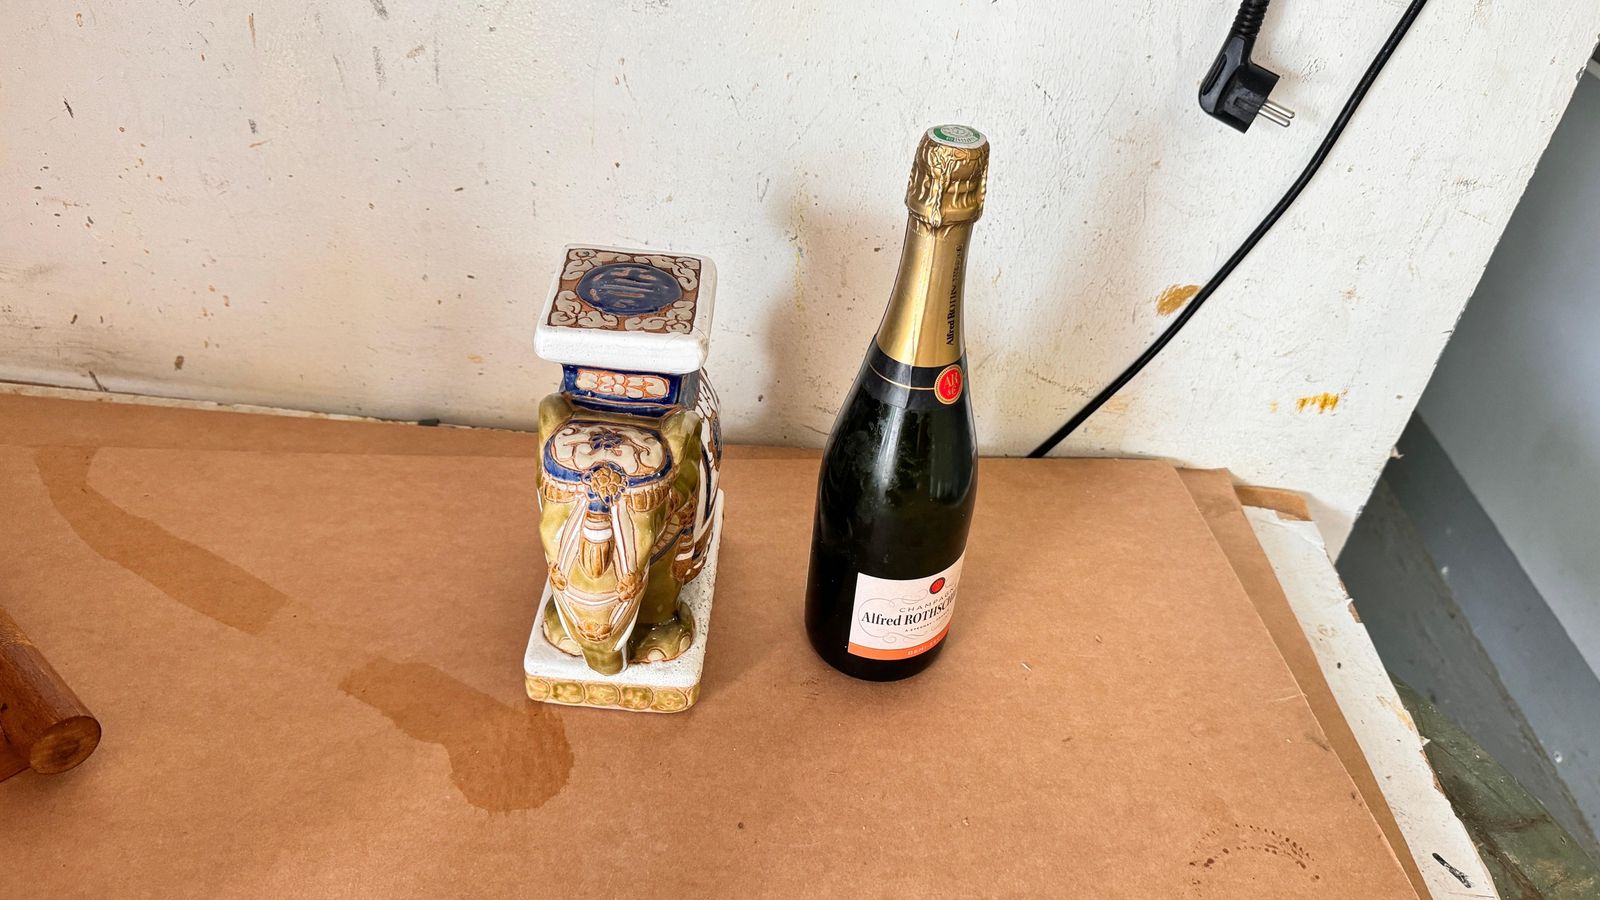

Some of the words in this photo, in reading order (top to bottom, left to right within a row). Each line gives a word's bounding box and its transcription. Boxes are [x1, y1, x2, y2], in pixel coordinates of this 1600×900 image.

[946, 320, 955, 346] Alfred
[899, 588, 955, 613] CHAMPAGN
[861, 611, 901, 626] Alfred
